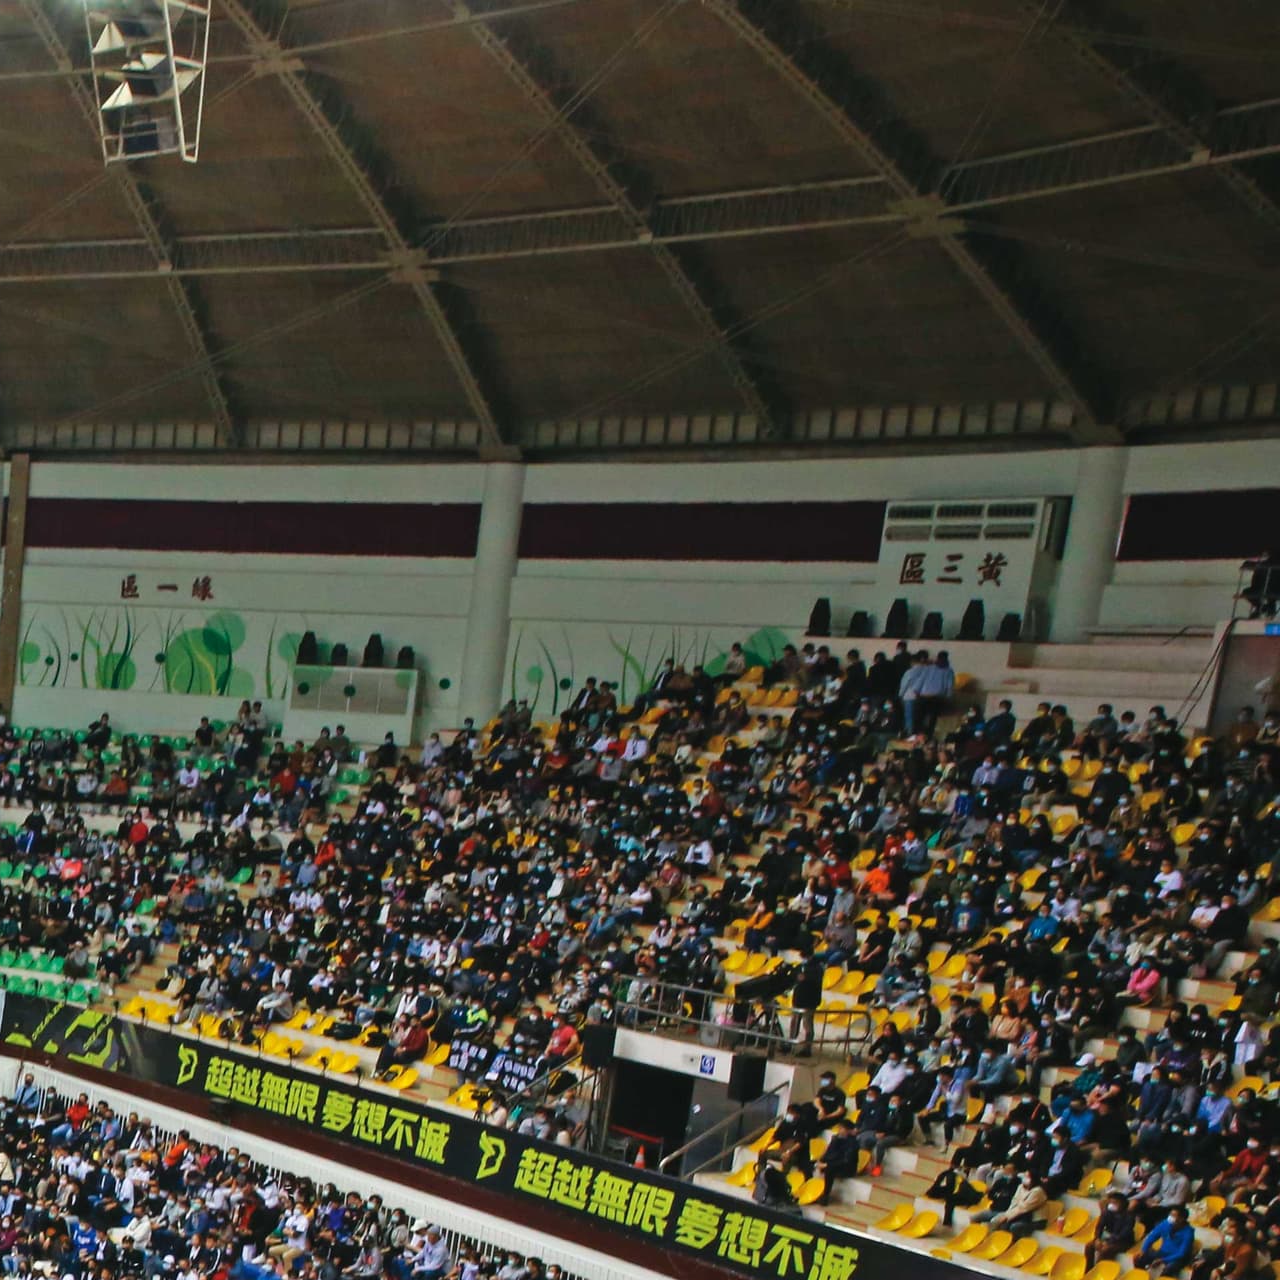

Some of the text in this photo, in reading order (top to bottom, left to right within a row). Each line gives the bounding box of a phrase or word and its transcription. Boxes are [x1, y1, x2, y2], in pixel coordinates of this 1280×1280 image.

[204, 1055, 451, 1165] 超越無限 夢想不滅
[513, 1146, 676, 1237] 超越無限
